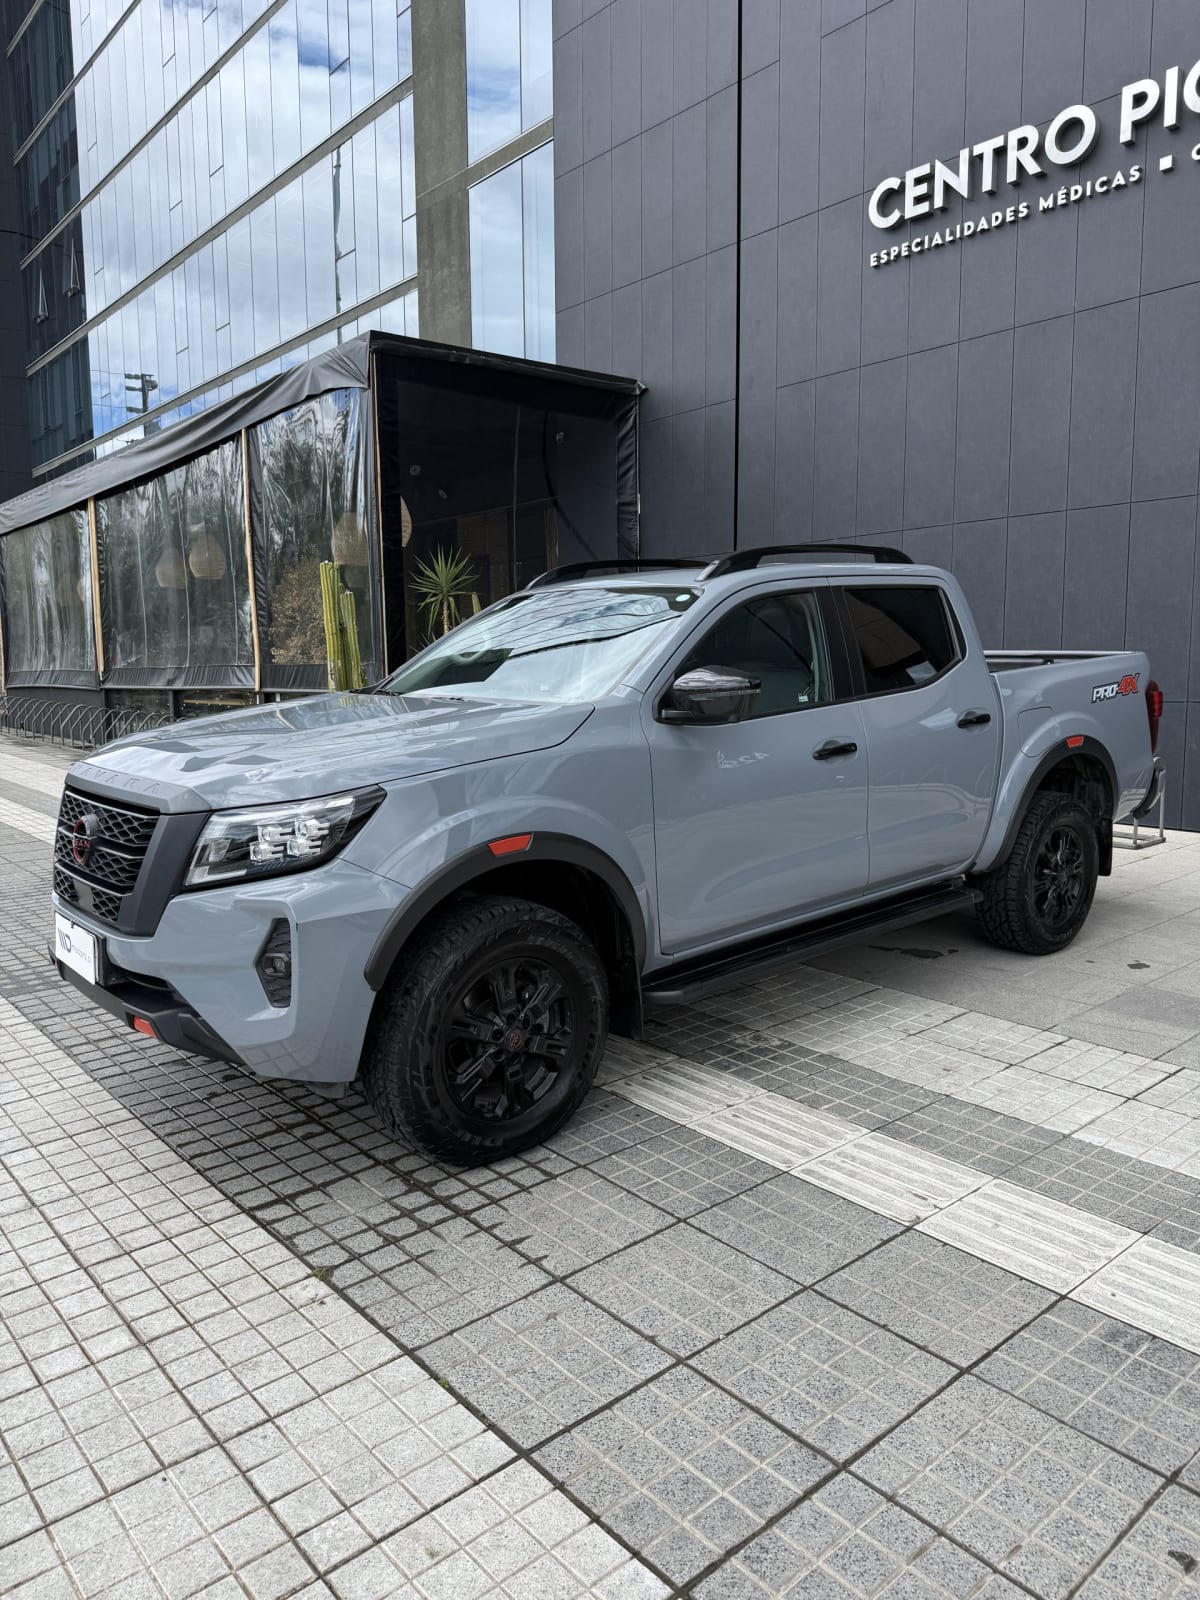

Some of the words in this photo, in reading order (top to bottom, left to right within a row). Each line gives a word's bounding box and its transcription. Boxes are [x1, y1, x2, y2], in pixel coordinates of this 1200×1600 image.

[868, 104, 1097, 229] CENTRO
[869, 202, 1029, 268] ESPECIALIDADES
[1038, 164, 1142, 212] MÉDICAS
